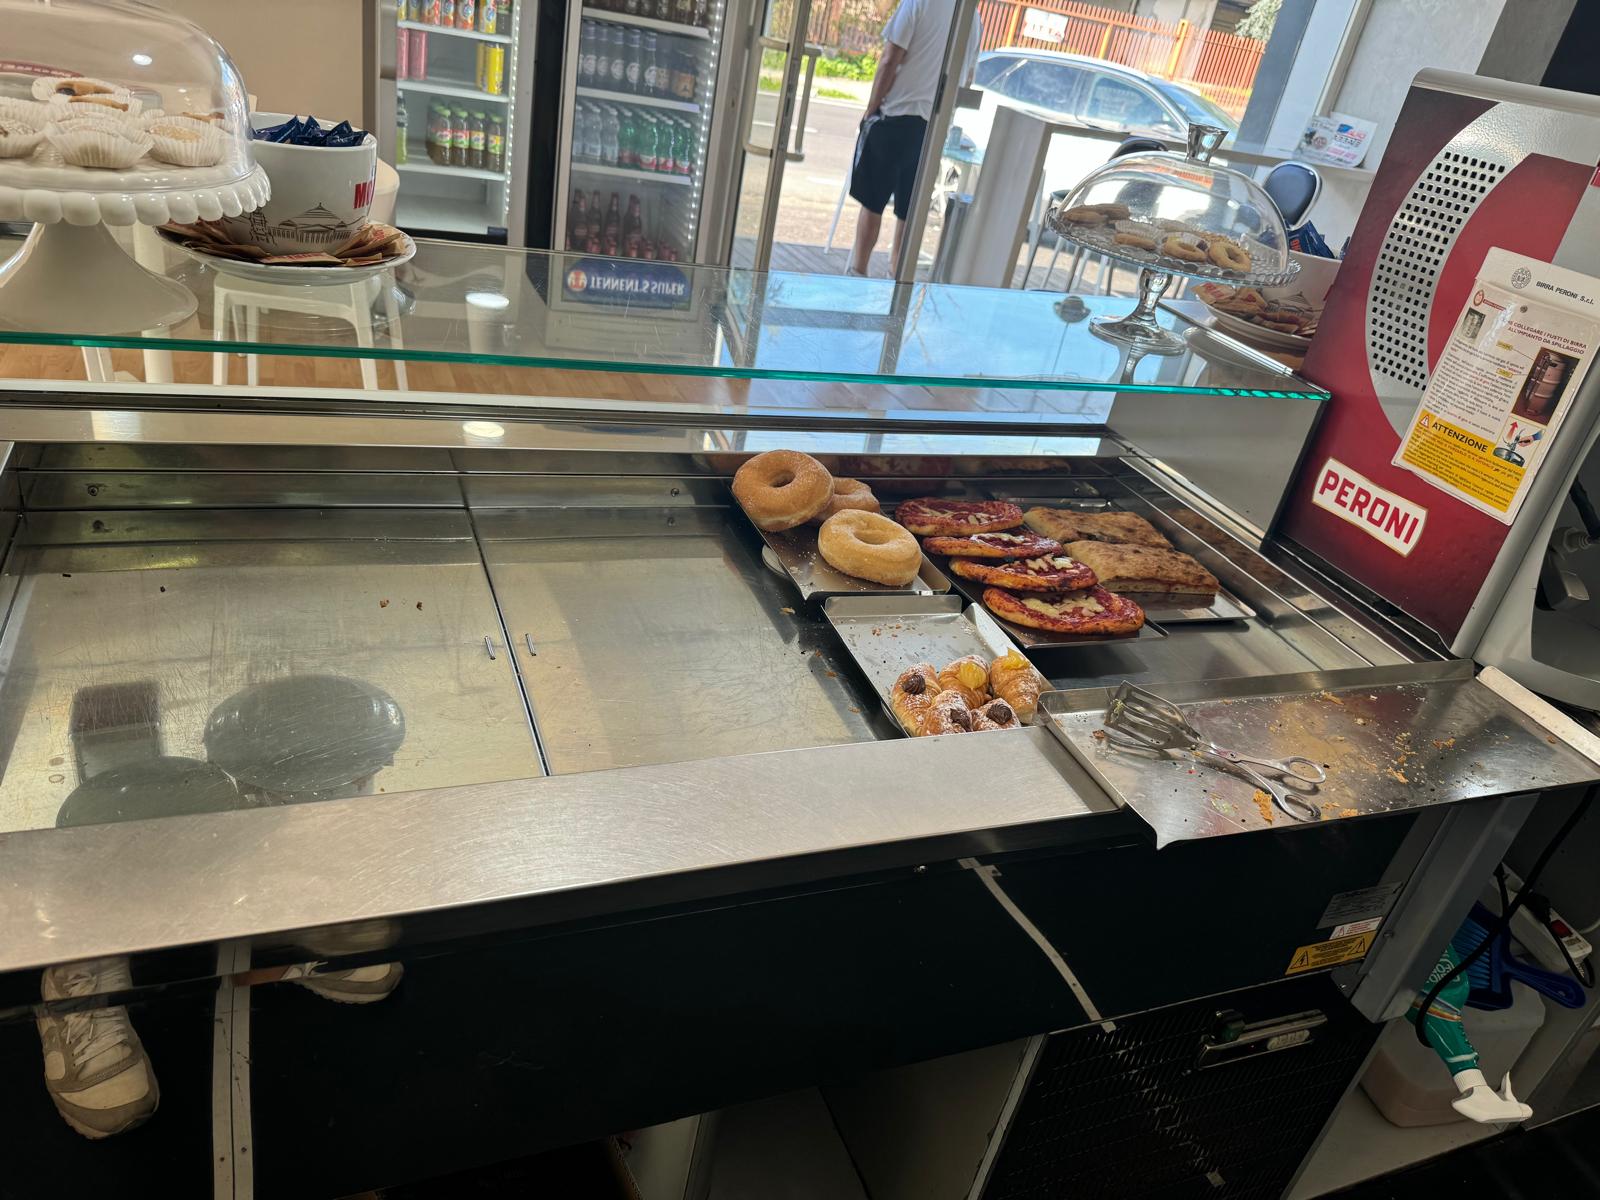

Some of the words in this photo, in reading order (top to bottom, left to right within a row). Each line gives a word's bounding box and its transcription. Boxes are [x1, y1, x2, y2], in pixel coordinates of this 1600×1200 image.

[1536, 281, 1554, 291] BIRRA
[1555, 288, 1577, 299] PERONI
[1580, 295, 1594, 305] S.r.l.
[1513, 322, 1543, 336] COLLEGARE
[1547, 332, 1562, 341] FUSTI
[1570, 340, 1587, 349] BIRRA
[1551, 340, 1585, 355] SPILLAGGIO
[1432, 422, 1488, 453] ATTENZIONE
[1319, 469, 1419, 545] PERONI
